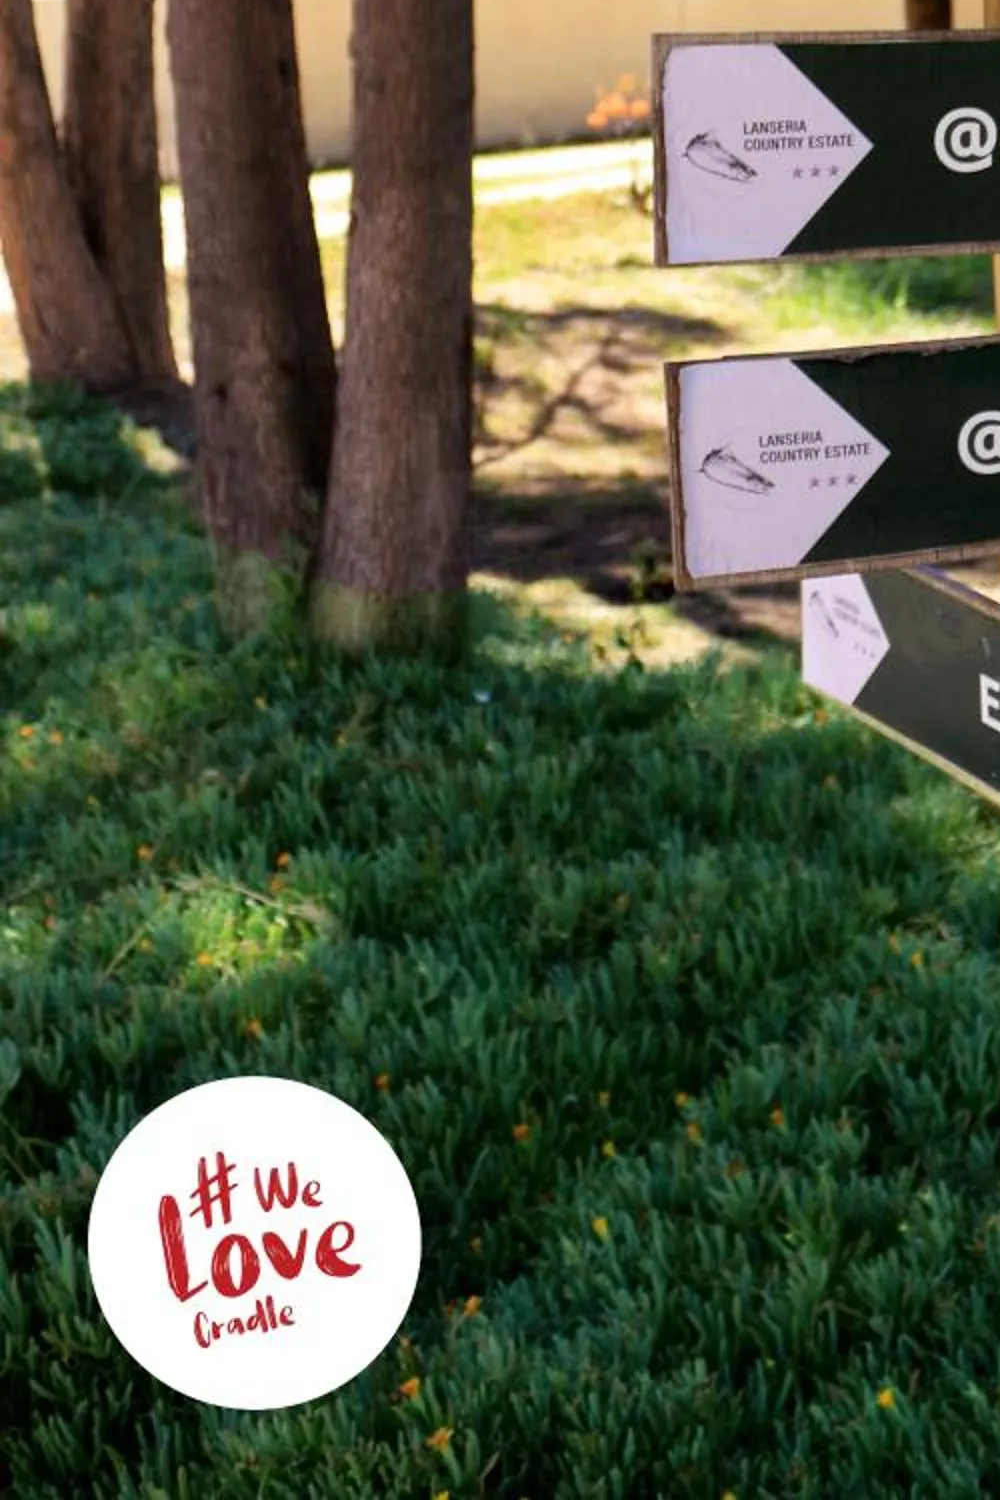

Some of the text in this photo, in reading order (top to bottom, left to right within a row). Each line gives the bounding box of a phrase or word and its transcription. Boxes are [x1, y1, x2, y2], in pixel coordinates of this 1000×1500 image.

[742, 119, 808, 136] LANSERIA
[743, 134, 854, 152] COUNTRY ESTATE
[758, 430, 824, 449] LANSERIA
[759, 442, 872, 465] COUNTRY ESTATE
